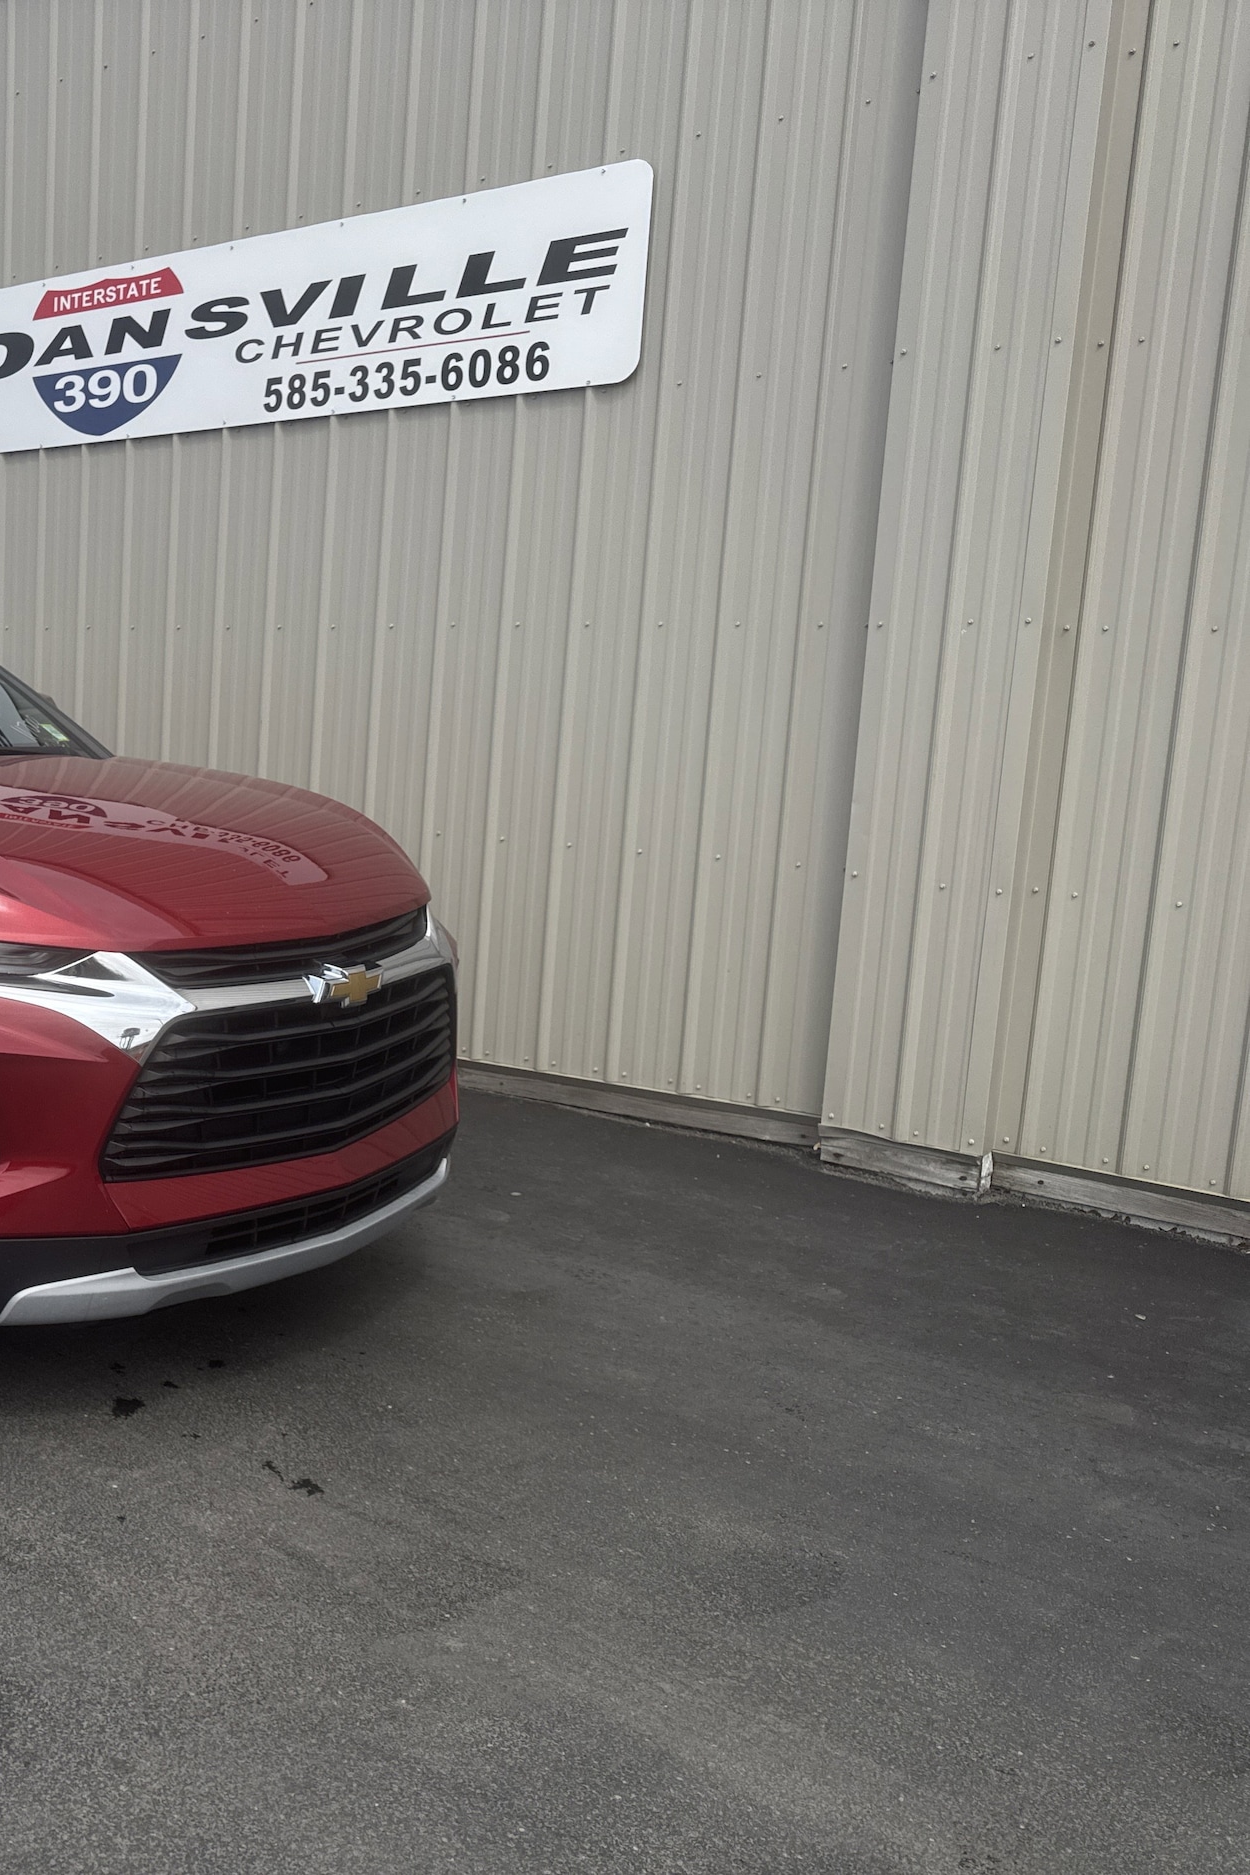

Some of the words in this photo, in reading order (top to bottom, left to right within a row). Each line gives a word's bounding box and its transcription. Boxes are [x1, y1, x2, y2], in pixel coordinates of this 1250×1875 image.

[53, 277, 162, 313] INTERSTATE
[235, 284, 611, 364] CHEVROLET
[53, 364, 158, 414] 390
[263, 341, 551, 413] 585-335-6086
